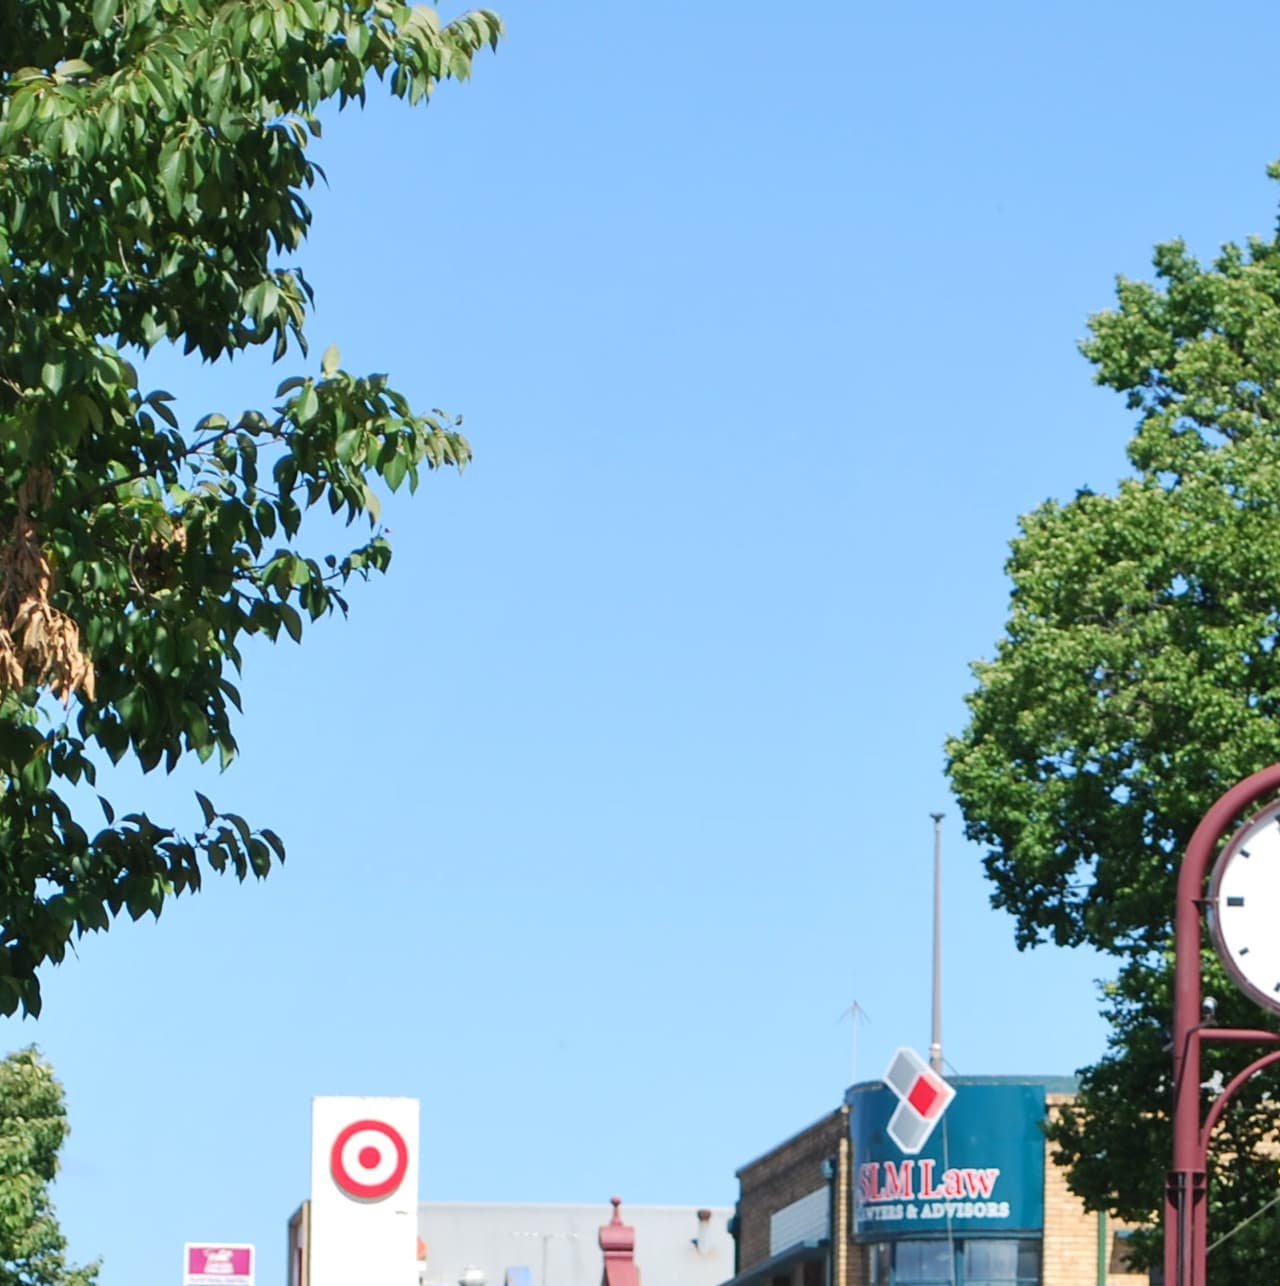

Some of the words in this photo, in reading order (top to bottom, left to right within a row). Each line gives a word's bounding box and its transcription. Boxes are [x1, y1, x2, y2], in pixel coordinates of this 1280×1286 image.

[918, 1158, 1001, 1200] Law
[906, 1205, 919, 1219] &
[920, 1202, 1010, 1219] ADVISORS
